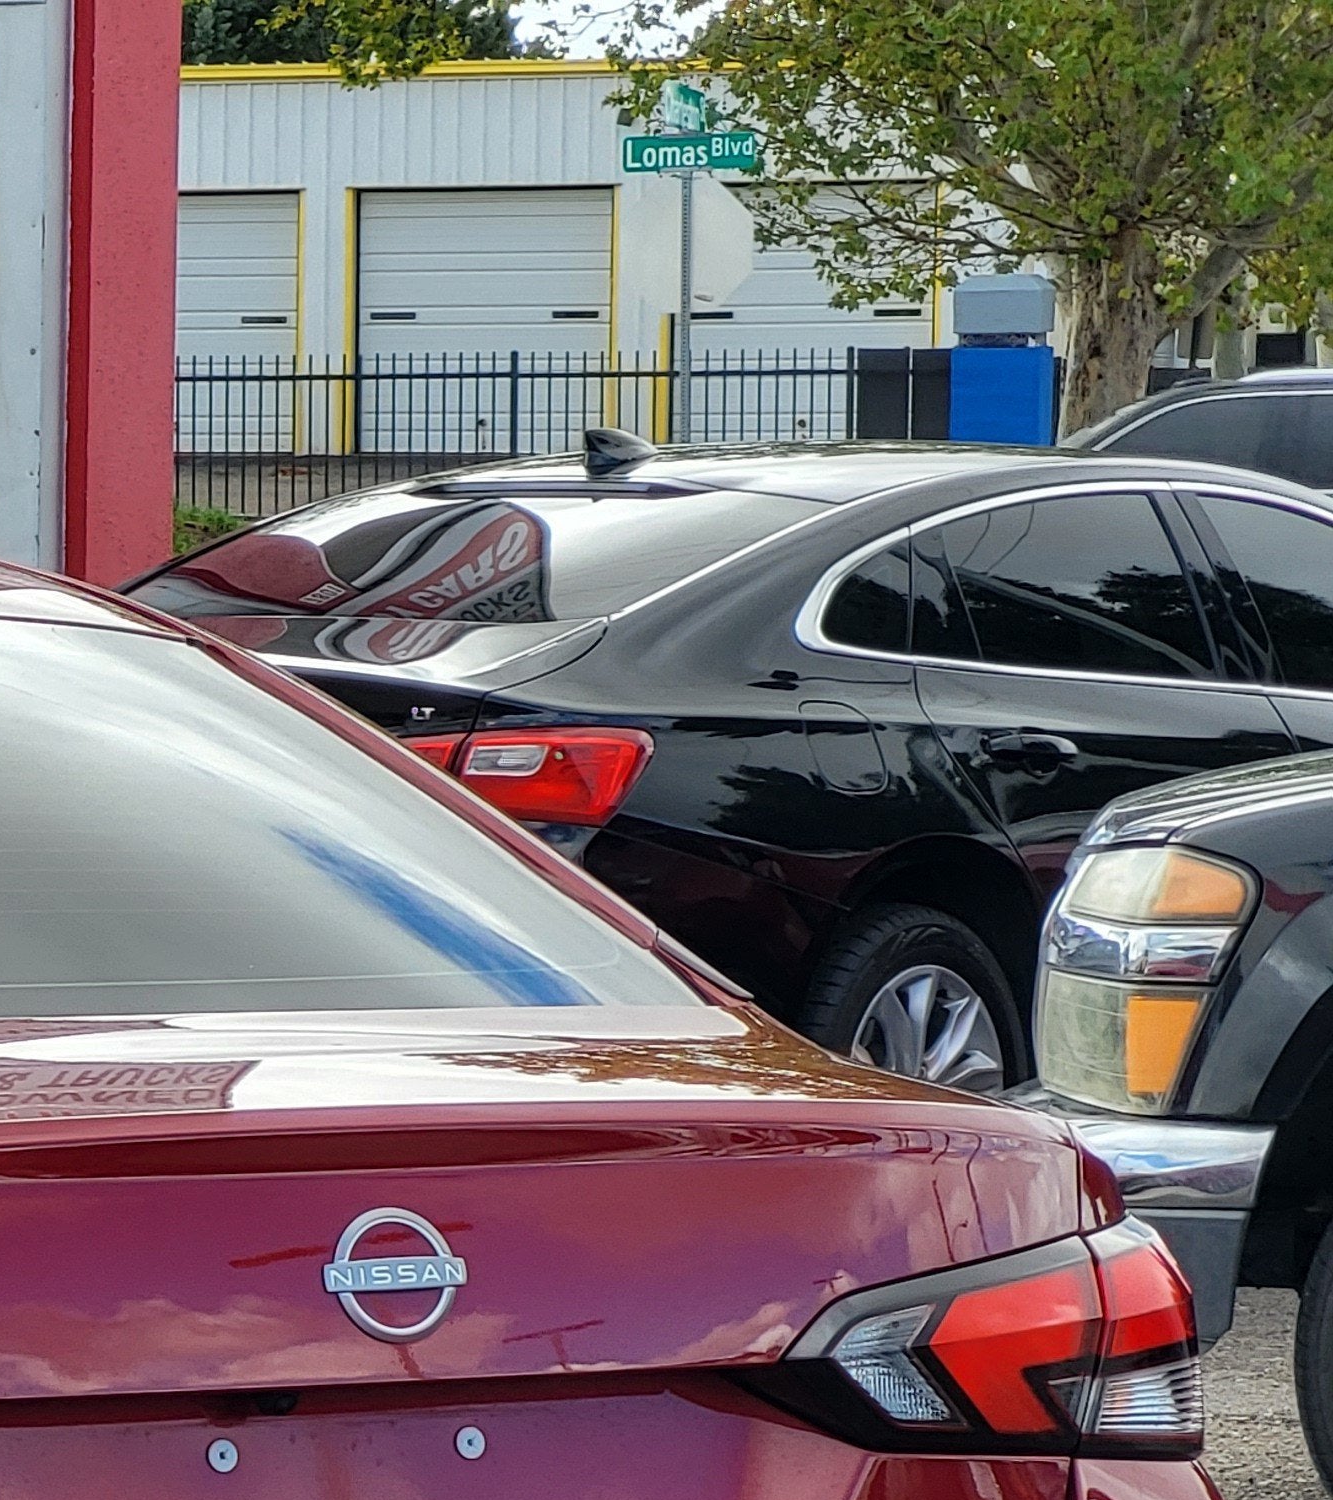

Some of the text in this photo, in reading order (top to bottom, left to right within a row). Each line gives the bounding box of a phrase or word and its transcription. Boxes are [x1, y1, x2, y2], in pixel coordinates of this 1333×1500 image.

[626, 136, 753, 168] Lomas Blvd
[329, 1263, 464, 1287] NISSAN
